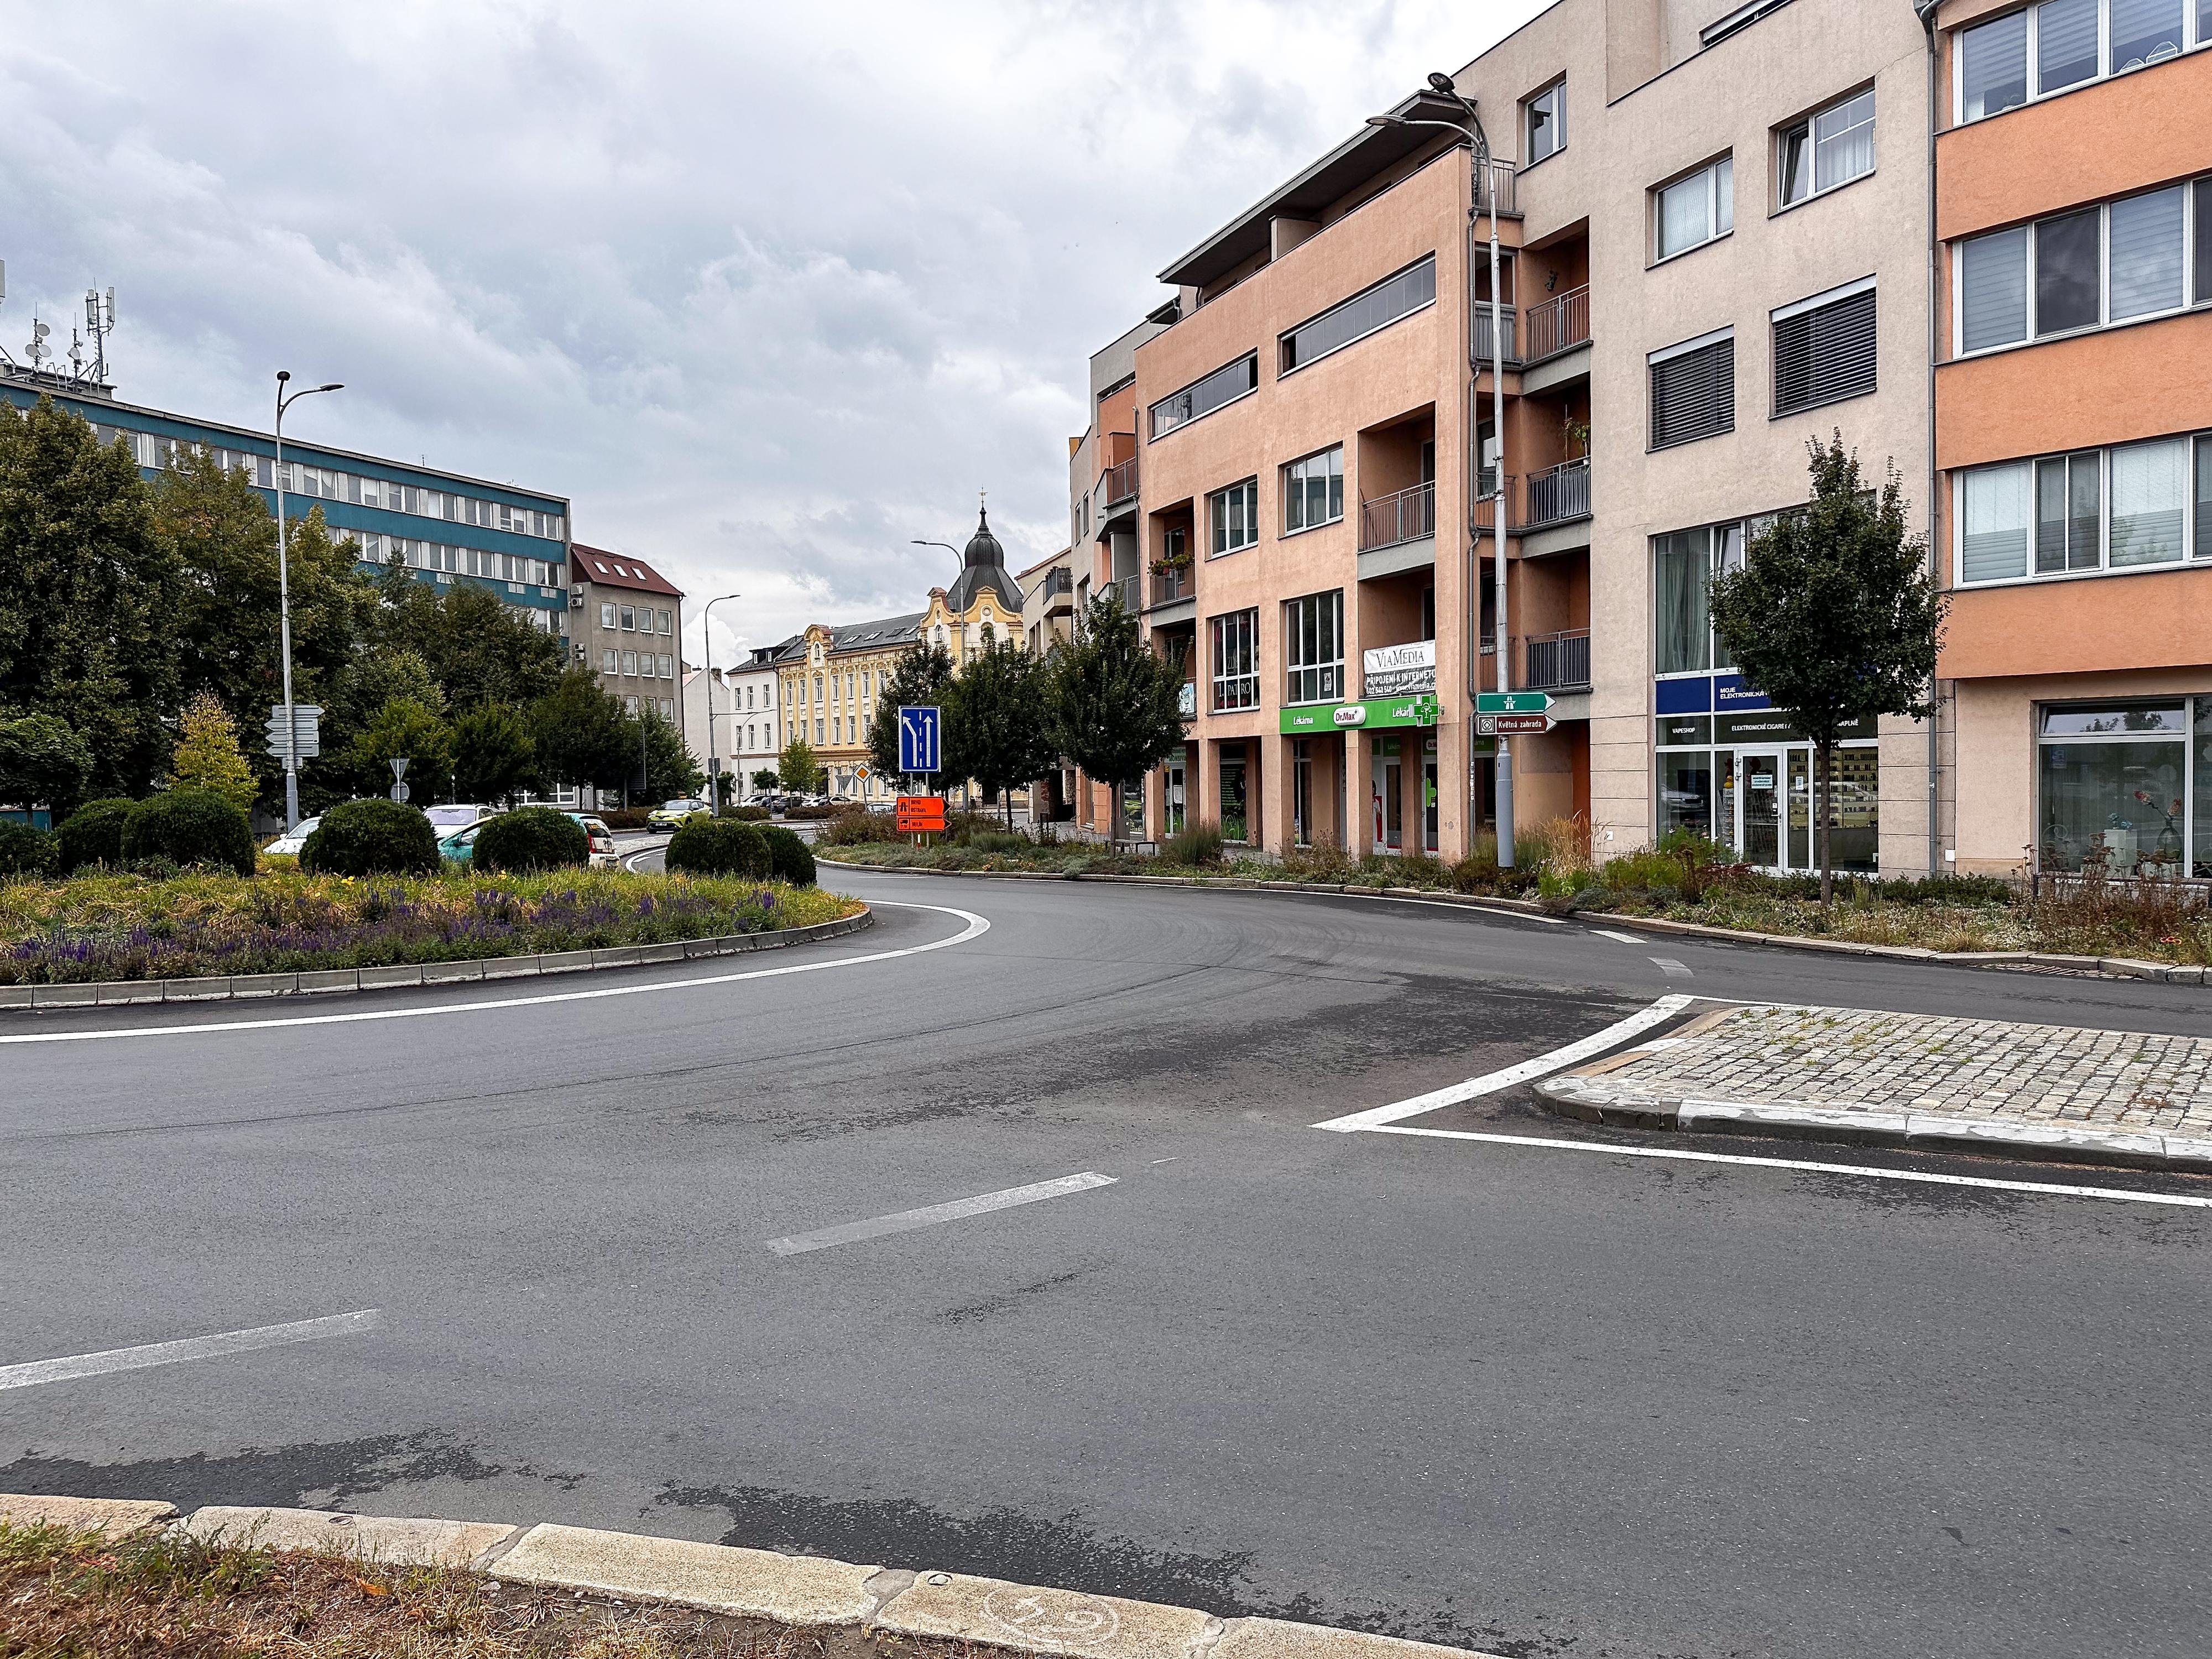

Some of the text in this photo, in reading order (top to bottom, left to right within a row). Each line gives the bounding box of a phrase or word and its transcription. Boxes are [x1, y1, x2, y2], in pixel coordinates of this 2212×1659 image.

[1366, 669, 1436, 686] PŘIPOJENÍ K INTERNETU
[1218, 682, 1251, 697] 1. PATRO
[1720, 689, 1765, 700] ELEKTRONICKÁ
[1392, 707, 1409, 718] Lékár
[1293, 715, 1314, 726] Lékárna
[1498, 720, 1542, 728] Květná zahrada
[1731, 723, 1766, 731] ELEKTRONICKÉ
